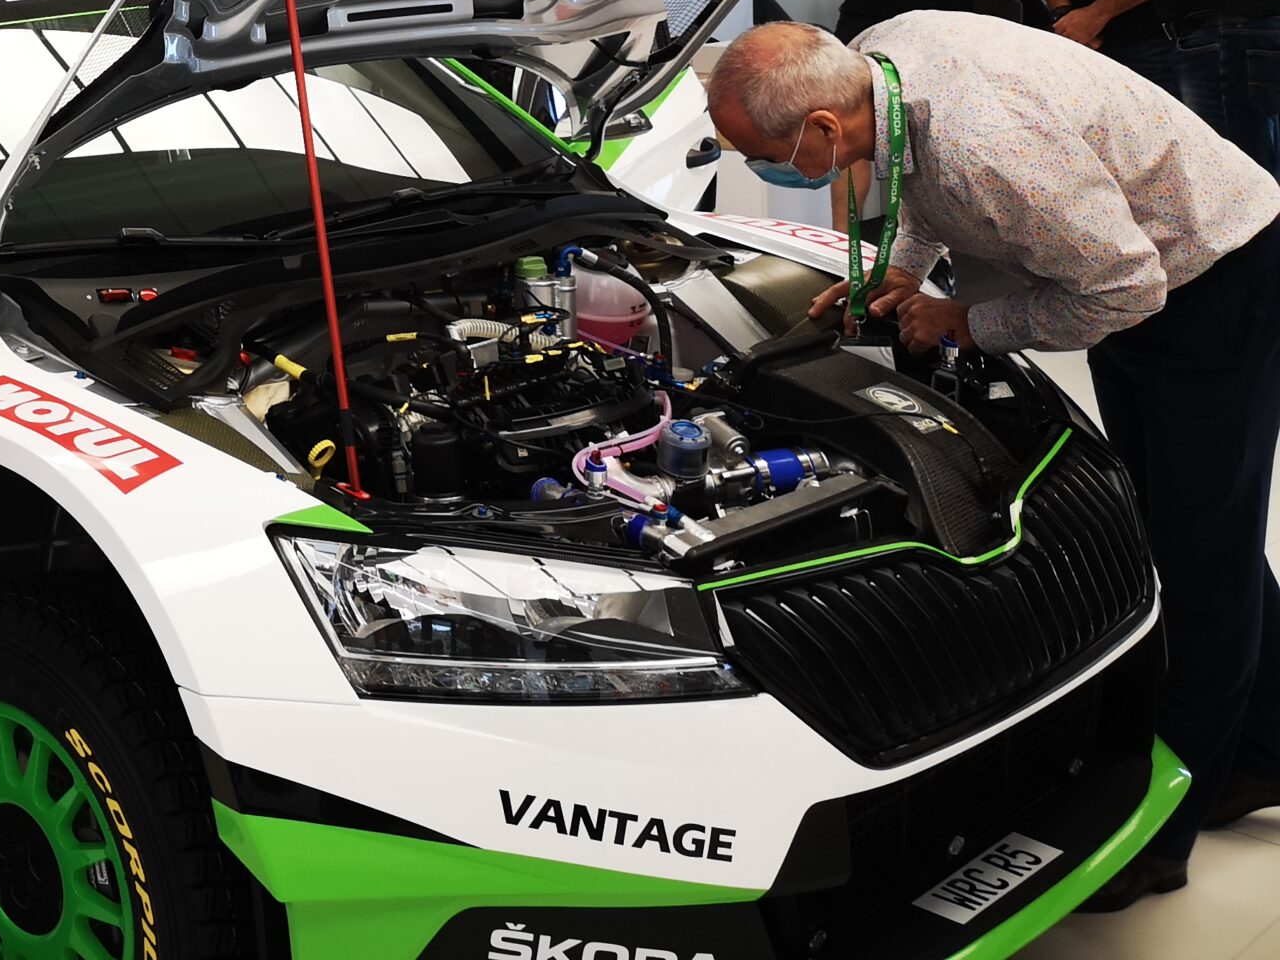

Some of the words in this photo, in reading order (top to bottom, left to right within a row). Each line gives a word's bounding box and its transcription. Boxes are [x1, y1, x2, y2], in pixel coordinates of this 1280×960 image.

[499, 789, 737, 862] VANTAGE
[930, 868, 1010, 911] WRC
[981, 843, 1043, 878] R5
